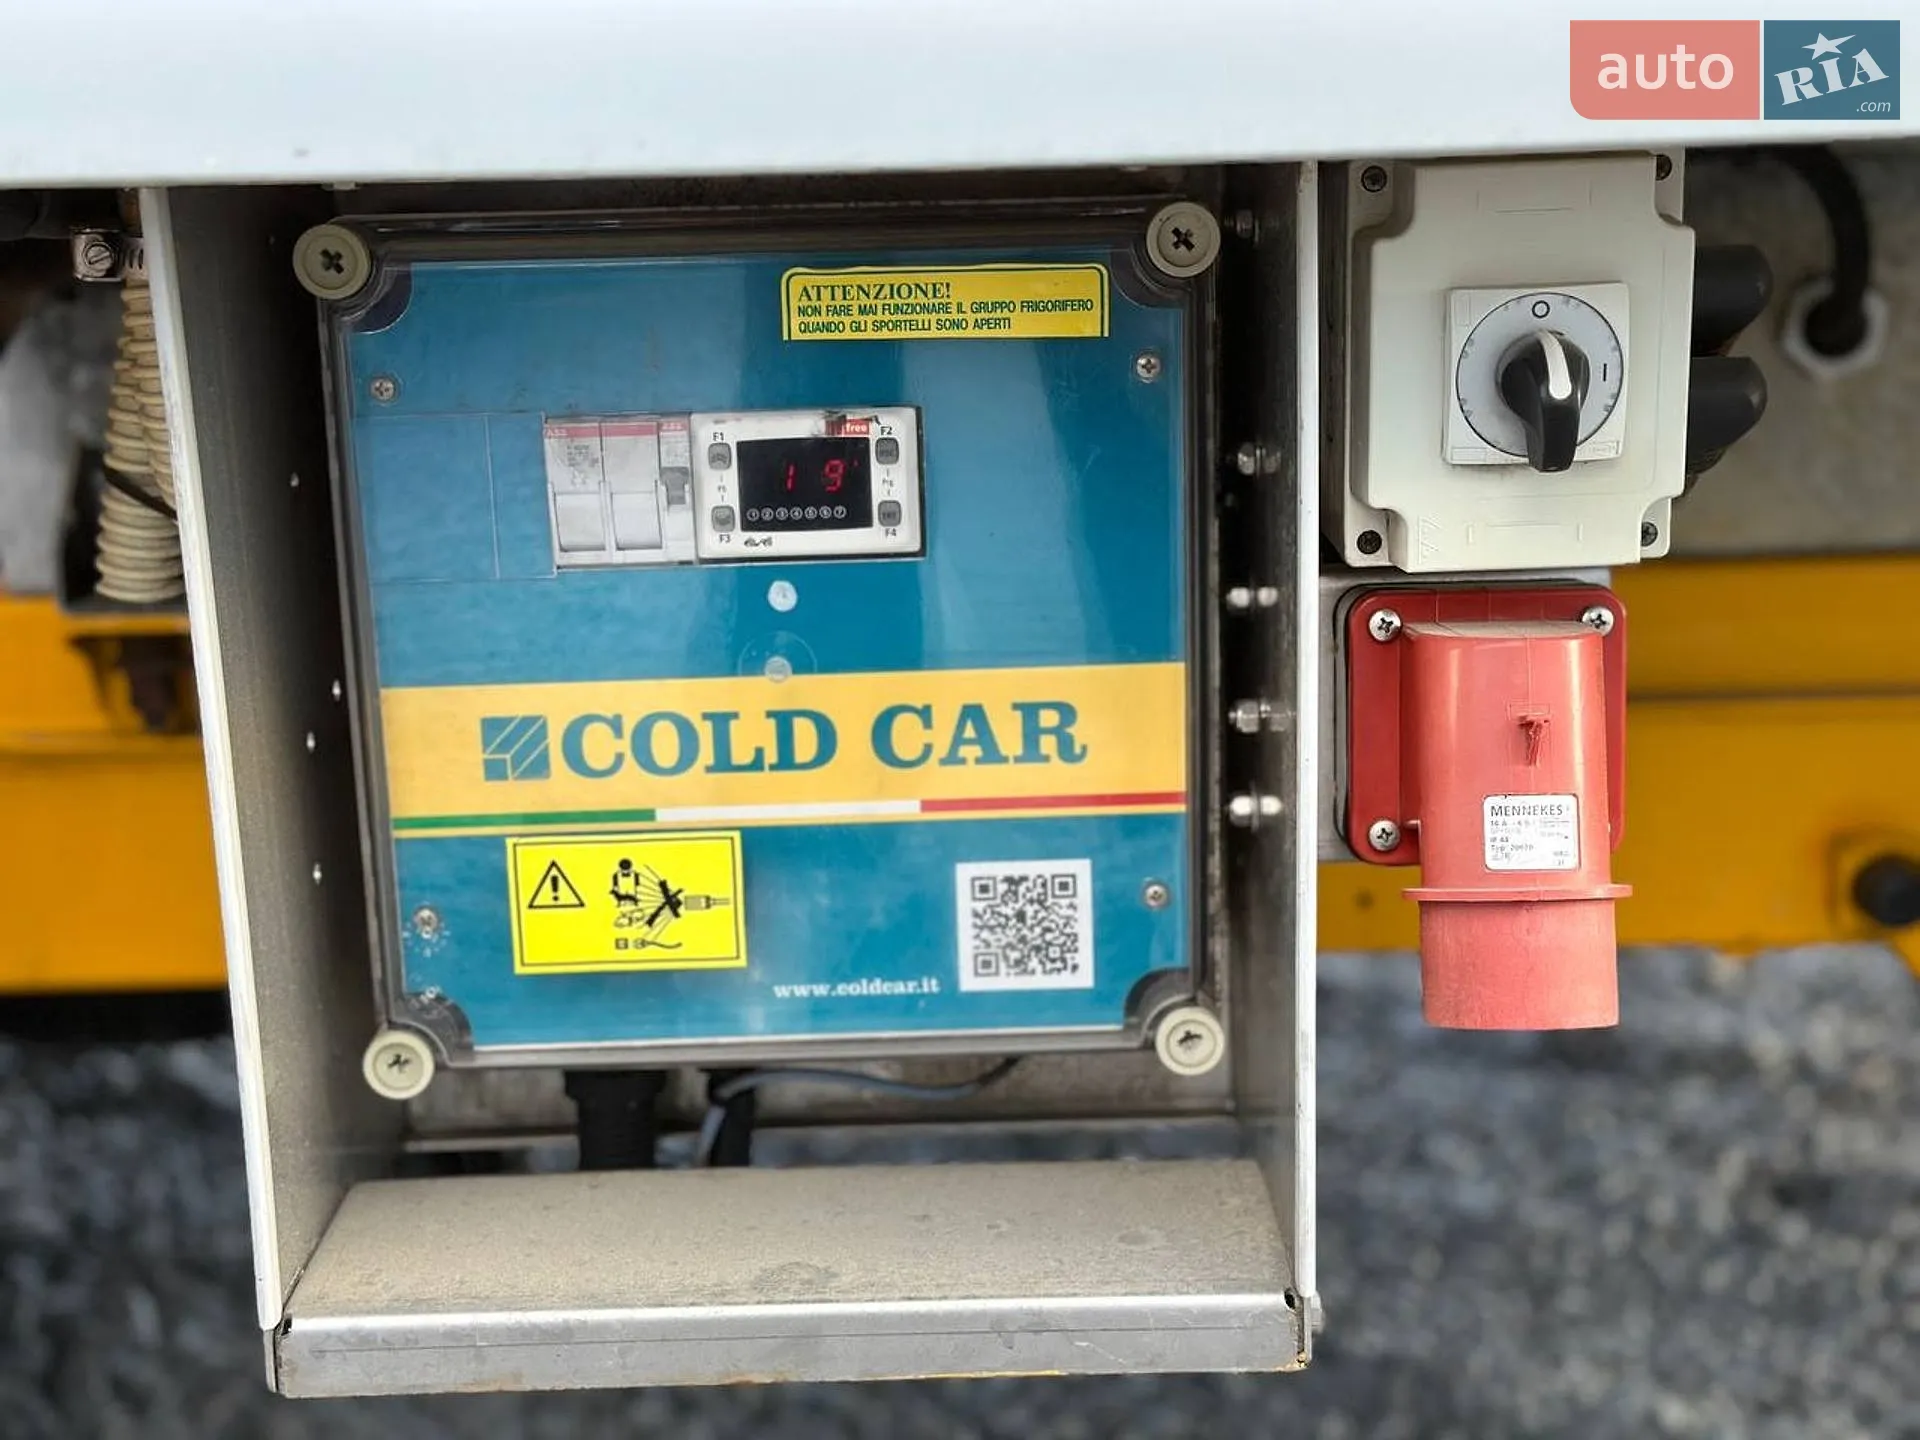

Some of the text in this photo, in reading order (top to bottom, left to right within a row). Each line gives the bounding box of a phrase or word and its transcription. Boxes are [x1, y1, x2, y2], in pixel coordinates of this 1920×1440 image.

[798, 282, 950, 301] ATTENZIONE!
[798, 299, 1094, 317] NON FARE MAI FUNZIONARE IL GRUPPO FRIGORIFERO
[798, 318, 1011, 334] QUANDO GLI SPORTELLI SONO APERTI
[844, 420, 868, 433] free
[880, 426, 893, 435] F2
[713, 432, 725, 441] F1
[561, 701, 1088, 778] COLD CAR
[1490, 804, 1563, 816] MENNEKES
[773, 977, 940, 999] www.coldcar.it
